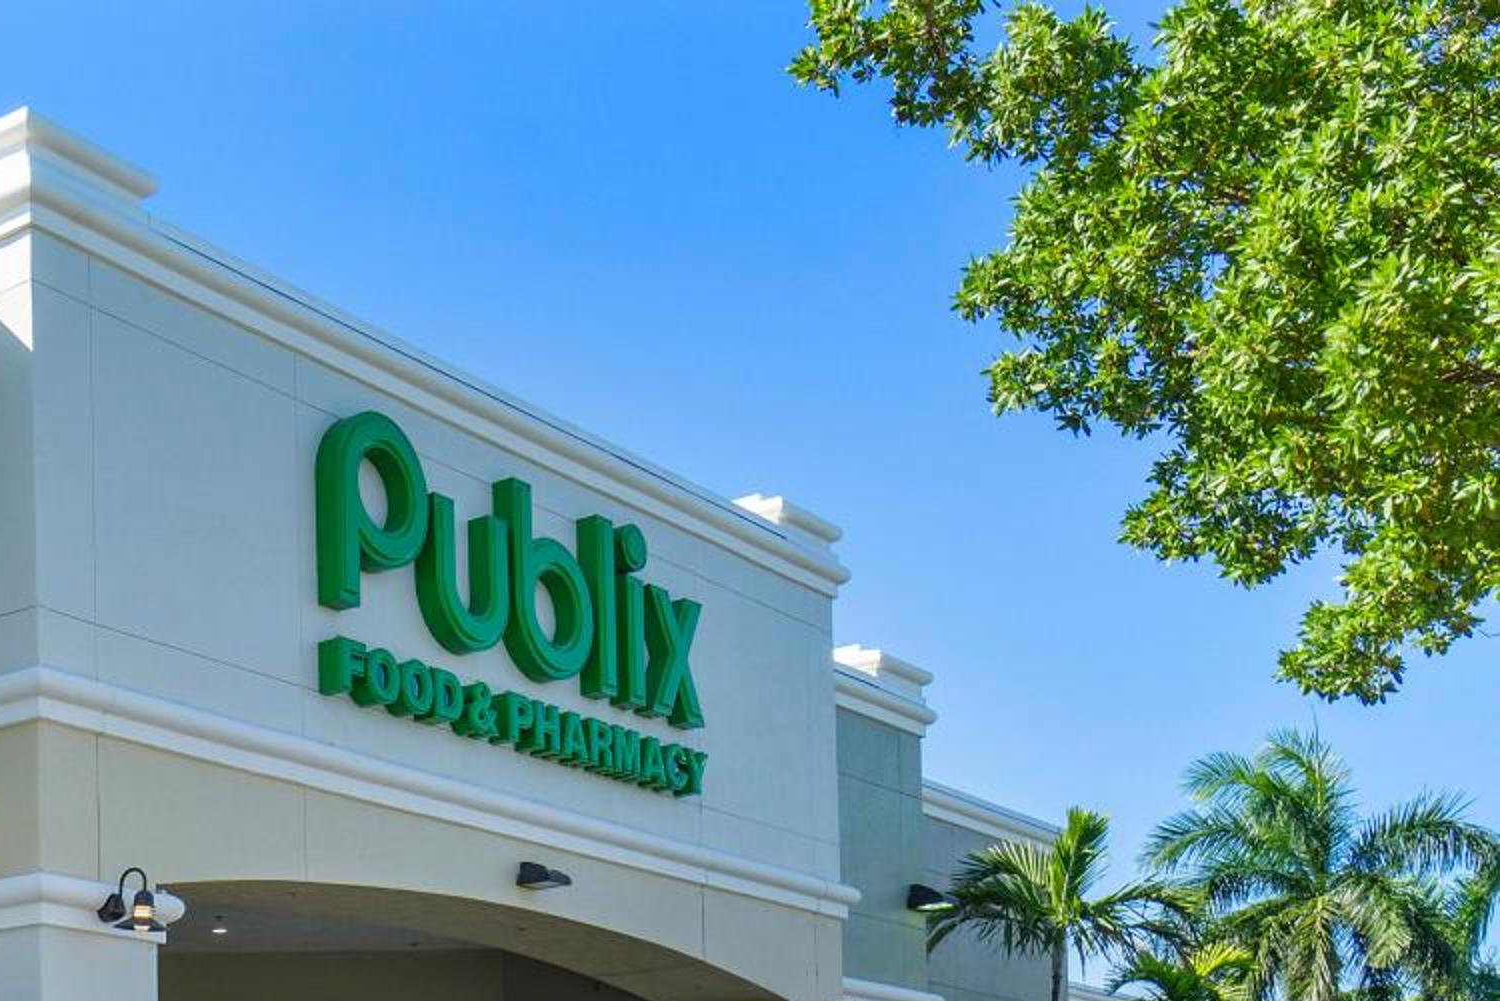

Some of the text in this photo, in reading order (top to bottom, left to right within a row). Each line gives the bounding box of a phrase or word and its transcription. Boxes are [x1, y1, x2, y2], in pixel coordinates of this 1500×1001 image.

[315, 410, 705, 730] Publix
[318, 635, 708, 796] FOOD & PHARMACY
